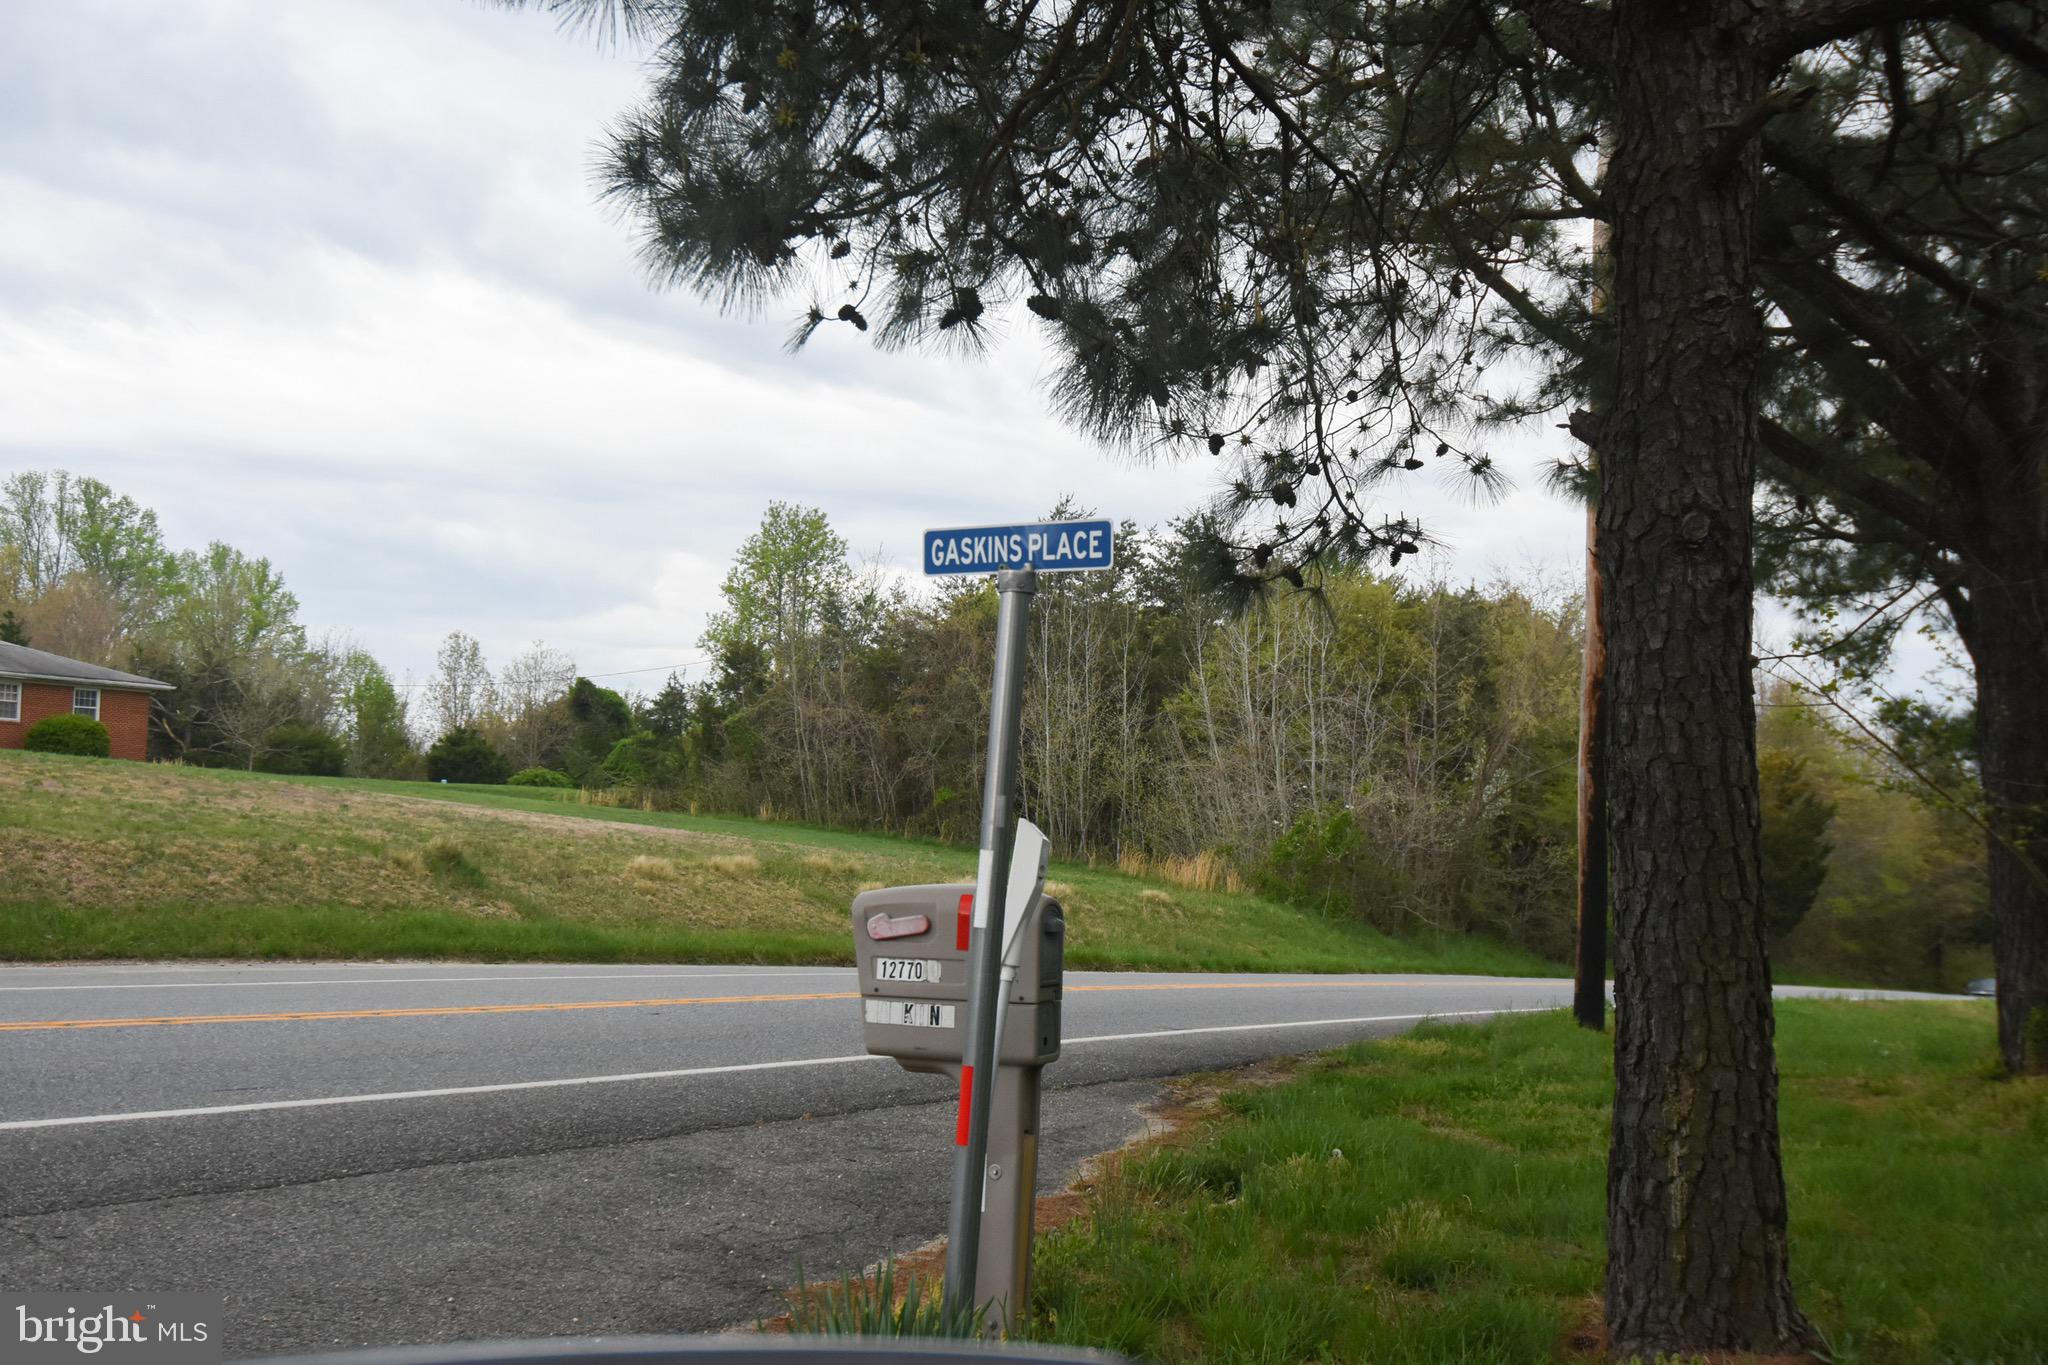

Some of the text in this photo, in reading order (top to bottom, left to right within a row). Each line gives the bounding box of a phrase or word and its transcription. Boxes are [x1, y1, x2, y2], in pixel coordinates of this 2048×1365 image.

[931, 530, 1103, 567] GASKINS PLACE
[881, 961, 923, 979] 12770
